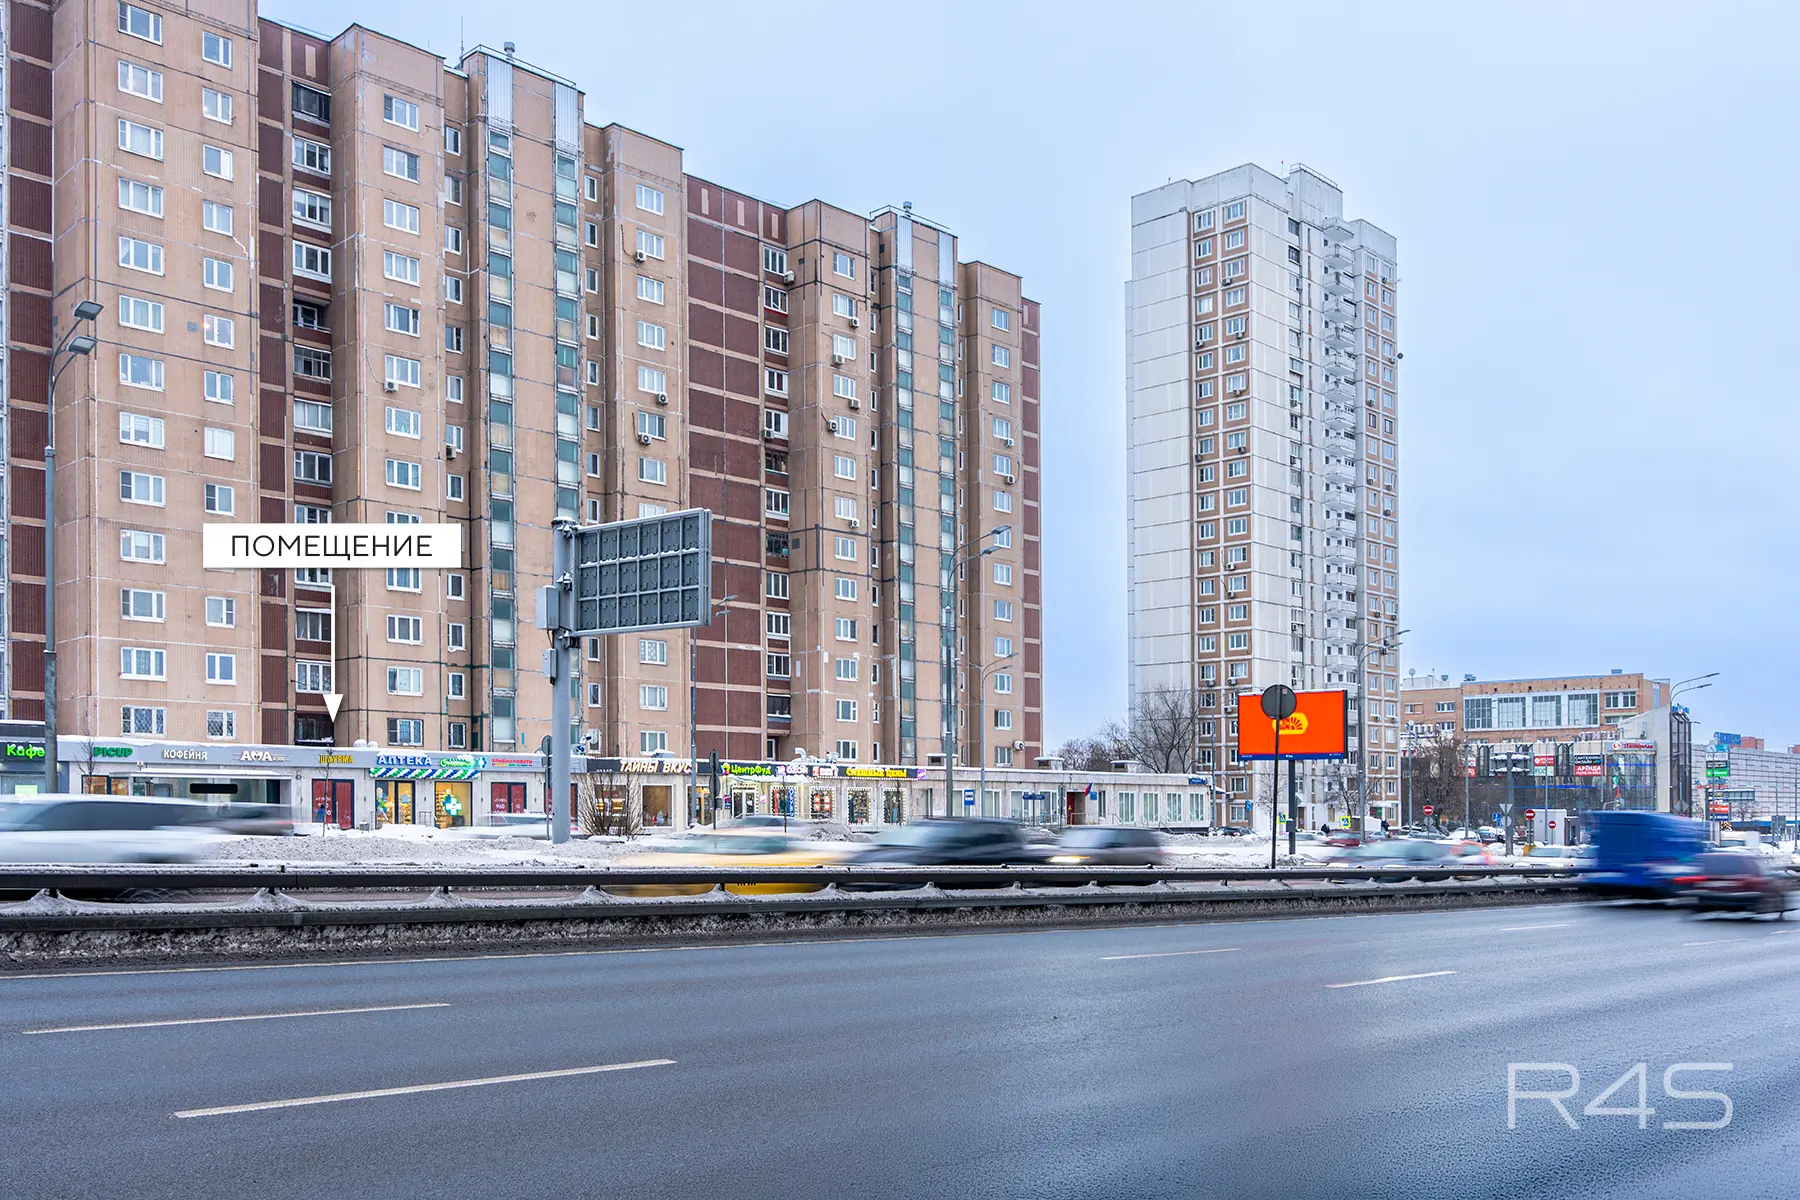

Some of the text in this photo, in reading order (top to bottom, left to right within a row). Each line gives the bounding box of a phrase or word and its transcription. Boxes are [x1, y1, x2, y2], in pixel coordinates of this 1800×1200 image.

[6, 744, 45, 759] Кафе
[93, 747, 133, 757] PICUP
[163, 749, 208, 761] КОФЕЙНЯ
[319, 755, 354, 764] ШАУРМА
[377, 755, 432, 766] АПТЕКА
[620, 760, 659, 773] ТАЙНЫ
